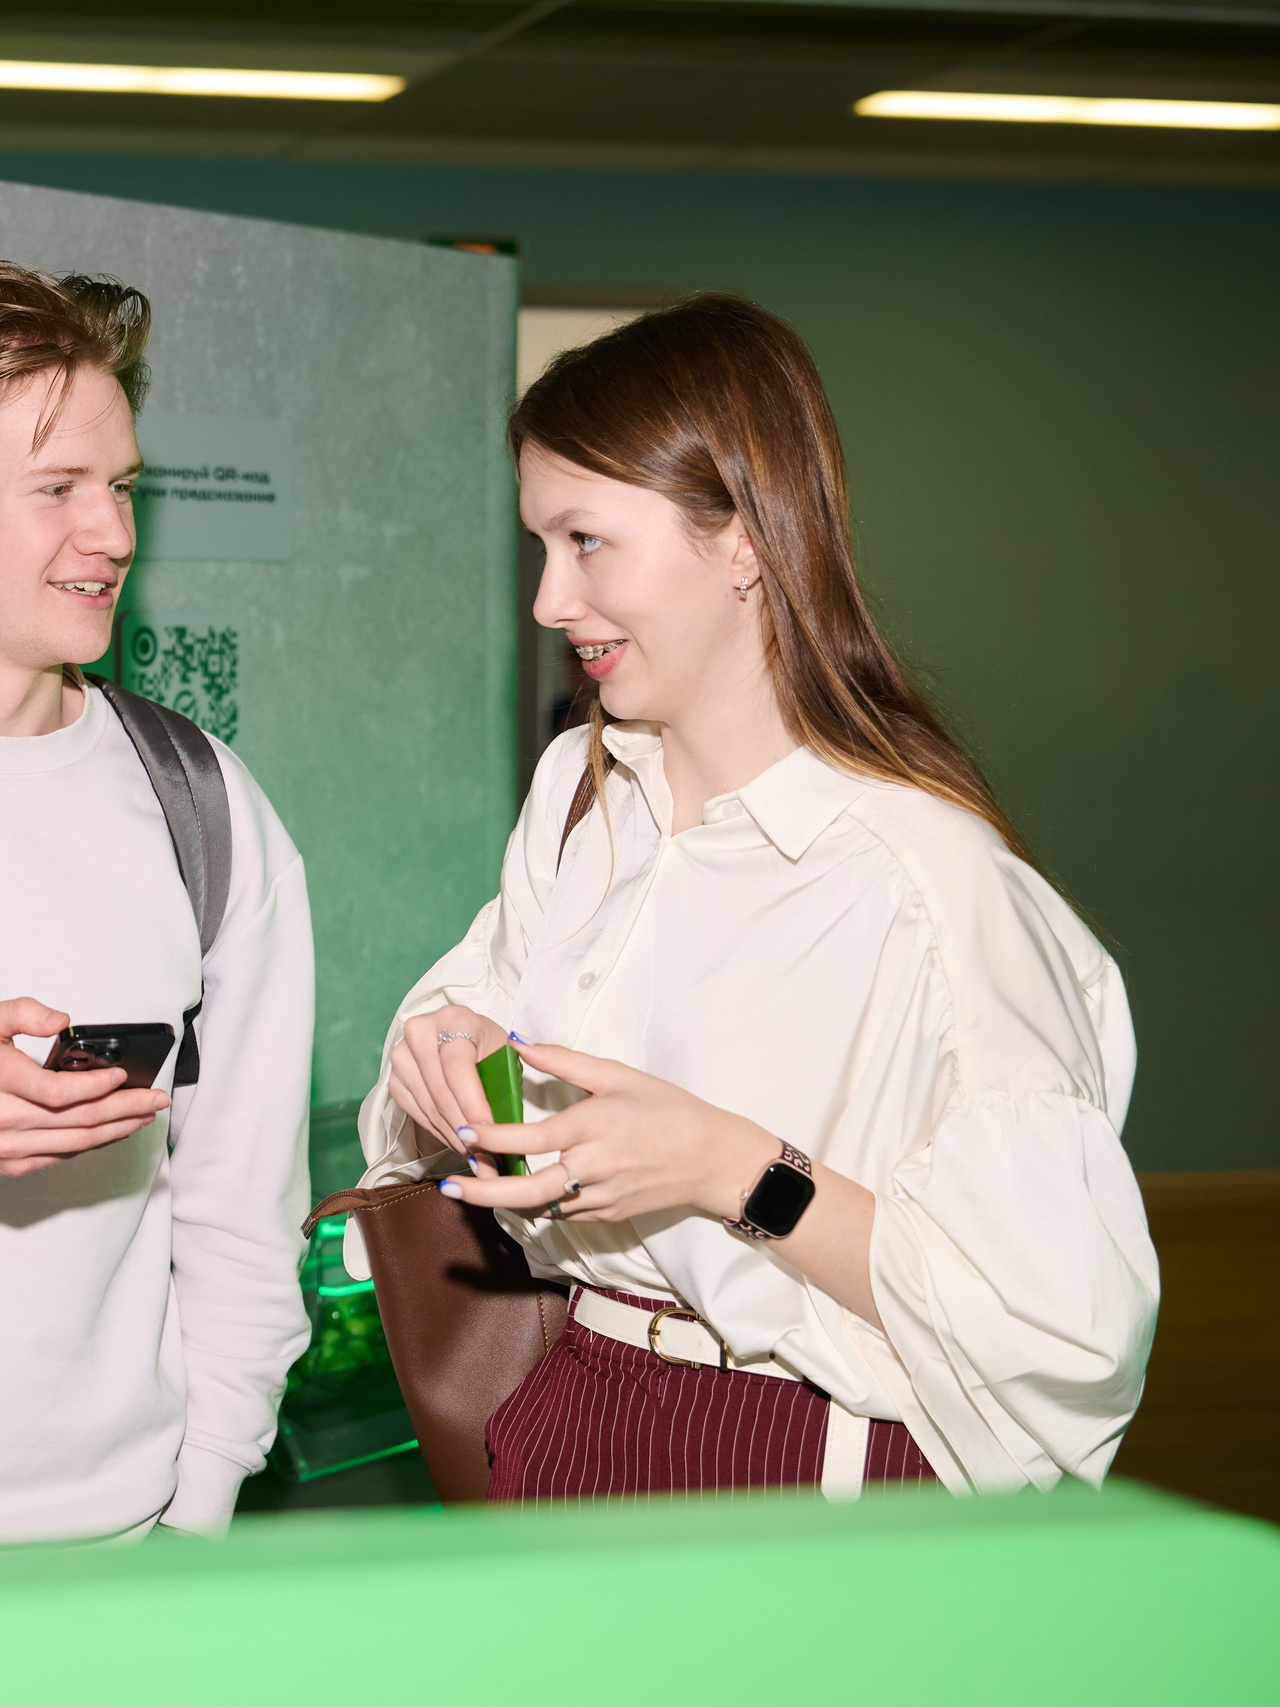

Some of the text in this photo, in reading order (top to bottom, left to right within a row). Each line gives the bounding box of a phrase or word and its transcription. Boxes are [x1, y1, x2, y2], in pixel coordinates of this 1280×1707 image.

[141, 465, 270, 484] канируй QR-код
[138, 486, 167, 501] учи
